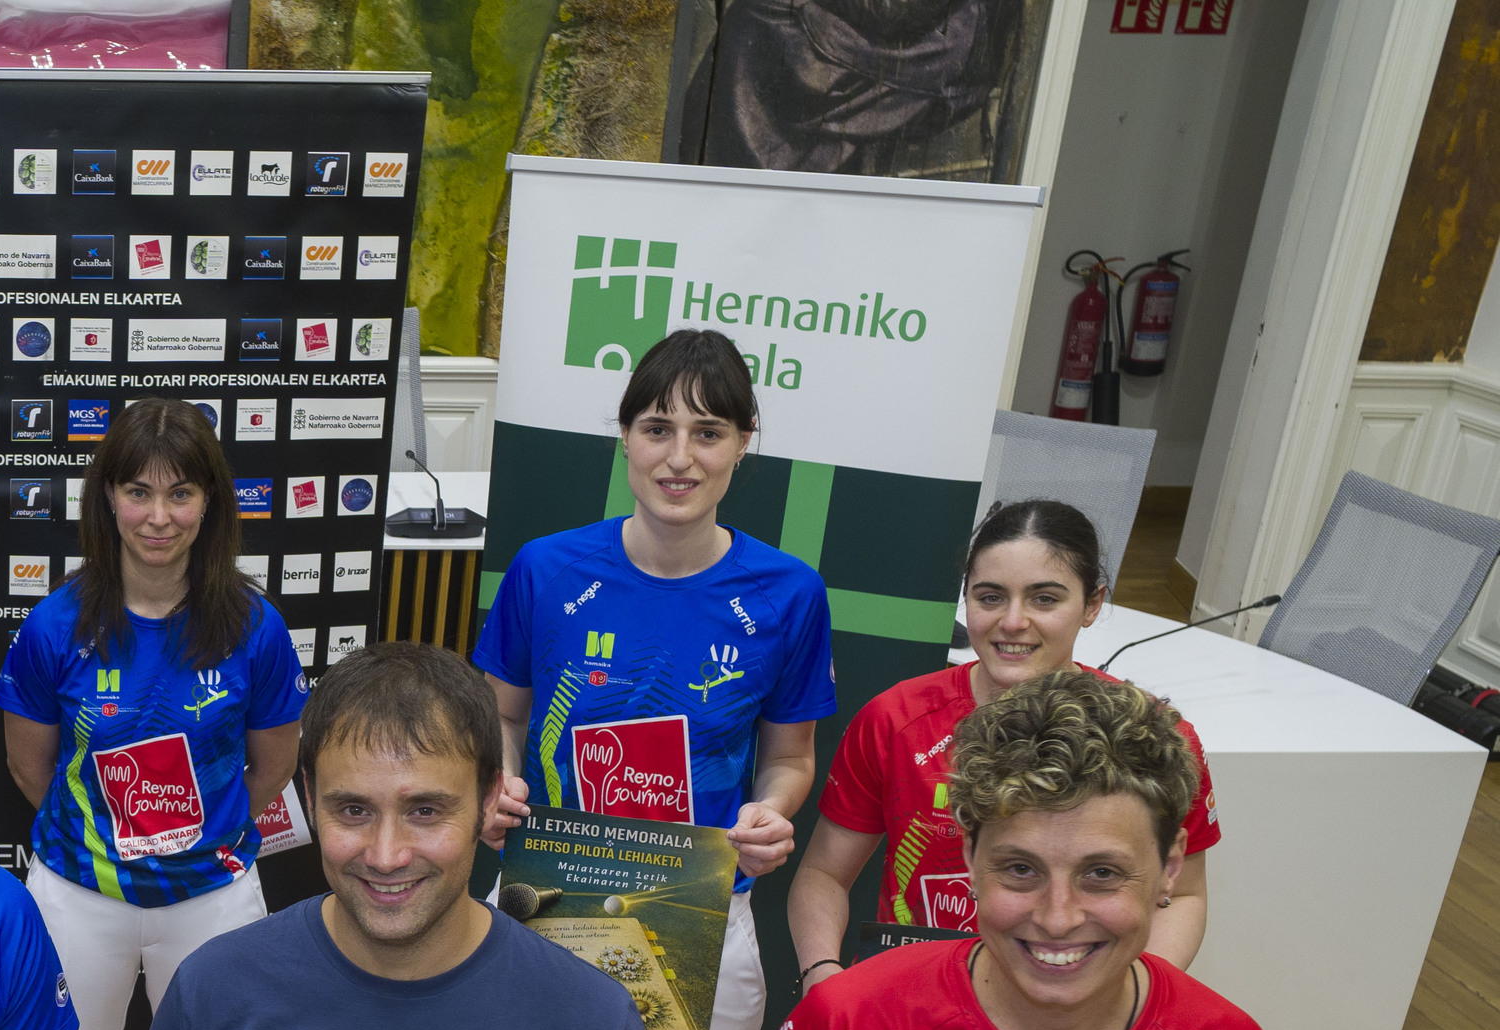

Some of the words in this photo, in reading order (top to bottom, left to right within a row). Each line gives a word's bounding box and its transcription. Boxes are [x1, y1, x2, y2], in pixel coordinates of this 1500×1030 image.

[74, 173, 114, 183] CaixaBank
[245, 259, 283, 268] CaixaBank
[104, 292, 182, 305] ELKARTEA
[682, 280, 927, 343] Hernaniko
[242, 341, 279, 350] CaixaBank
[728, 340, 803, 390] ala
[43, 375, 116, 387] EMAKUME
[121, 374, 185, 387] PILOTARI
[189, 373, 308, 386] PROFESIONALEN
[312, 373, 387, 385] ELKARTEA
[283, 568, 319, 580] berria
[576, 580, 603, 607] negua
[728, 596, 757, 636] berria
[623, 766, 675, 788] Reyno
[141, 780, 185, 797] Reyno
[605, 775, 688, 812] Gourmet
[128, 788, 200, 817] Gourmet
[526, 816, 540, 830] II.
[545, 818, 600, 837] ETXEKO
[604, 826, 693, 849] MEMORIALA
[525, 838, 570, 854] BERTSO
[574, 843, 615, 859] PILOTA
[618, 849, 683, 868] LEHIAKETA
[557, 861, 629, 878] Maiatzaren
[635, 871, 668, 883] 1etik
[566, 874, 629, 889] Ekainaren
[636, 881, 657, 891] 7ra
